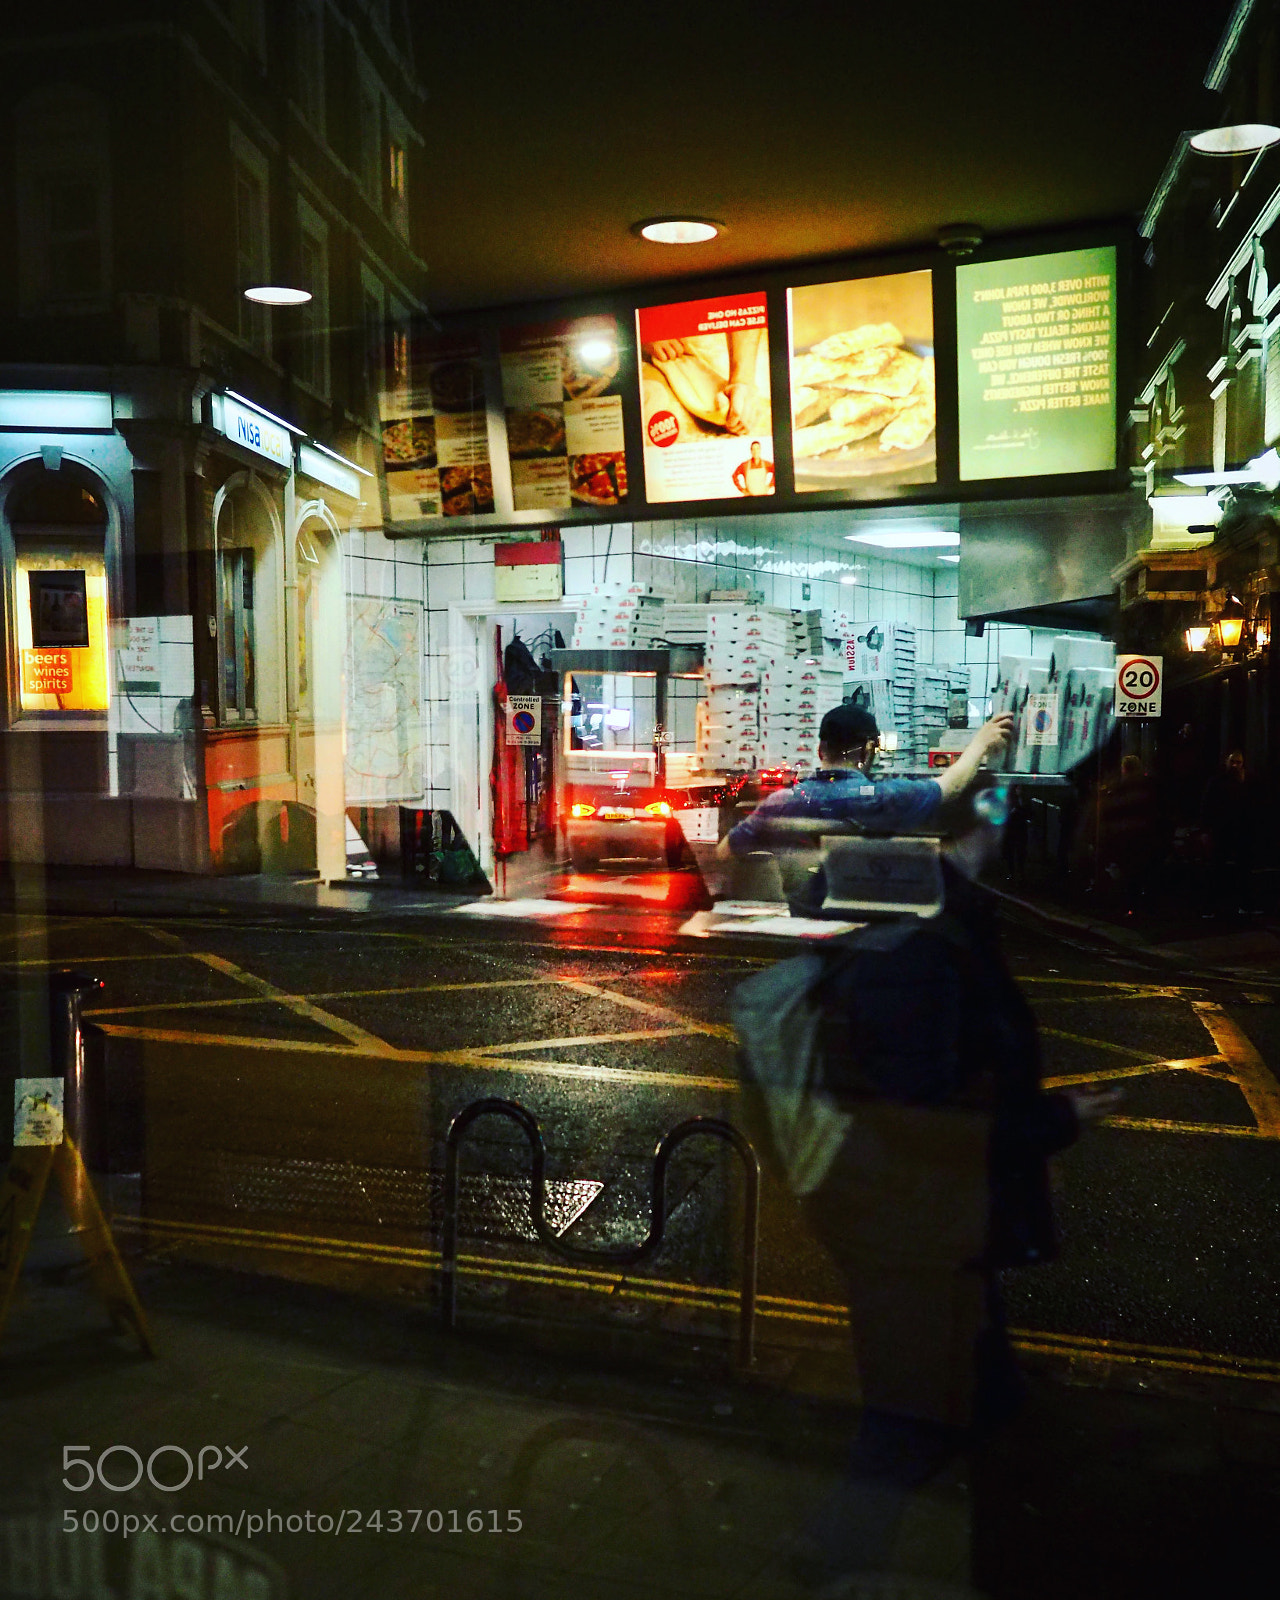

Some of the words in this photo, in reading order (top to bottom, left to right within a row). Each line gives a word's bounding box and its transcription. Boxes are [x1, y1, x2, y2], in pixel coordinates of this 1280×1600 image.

[25, 652, 67, 664] beers
[34, 666, 69, 676] wines
[30, 678, 67, 691] spirits
[1126, 671, 1153, 687] 20
[1120, 702, 1156, 712] ZONE
